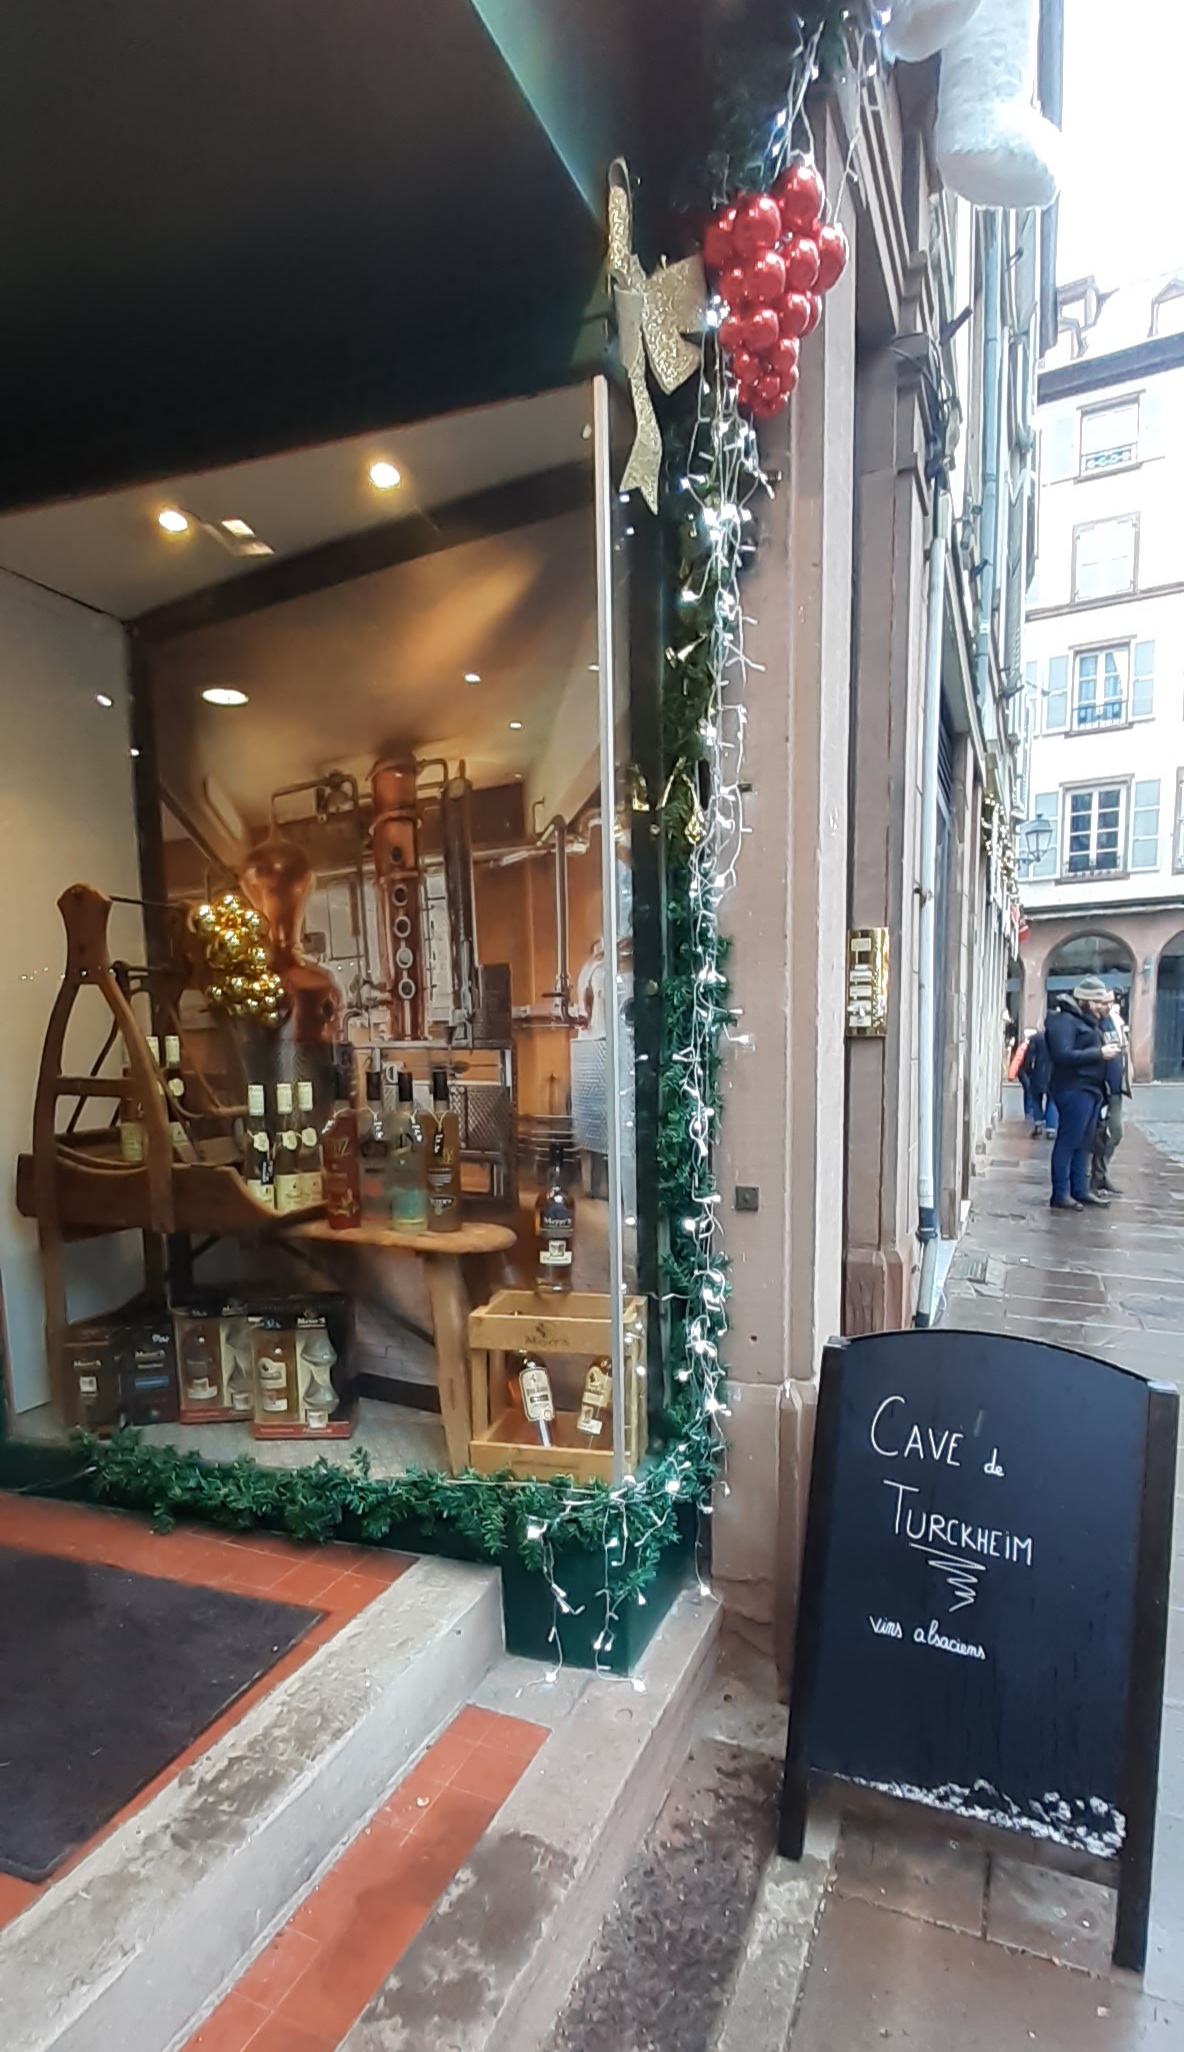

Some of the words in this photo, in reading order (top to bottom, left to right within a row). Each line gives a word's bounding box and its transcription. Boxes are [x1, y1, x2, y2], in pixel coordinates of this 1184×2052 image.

[870, 1395, 965, 1467] CAVE
[984, 1447, 1005, 1477] de
[869, 1615, 903, 1639] vins
[913, 1619, 986, 1660] alsaciens
